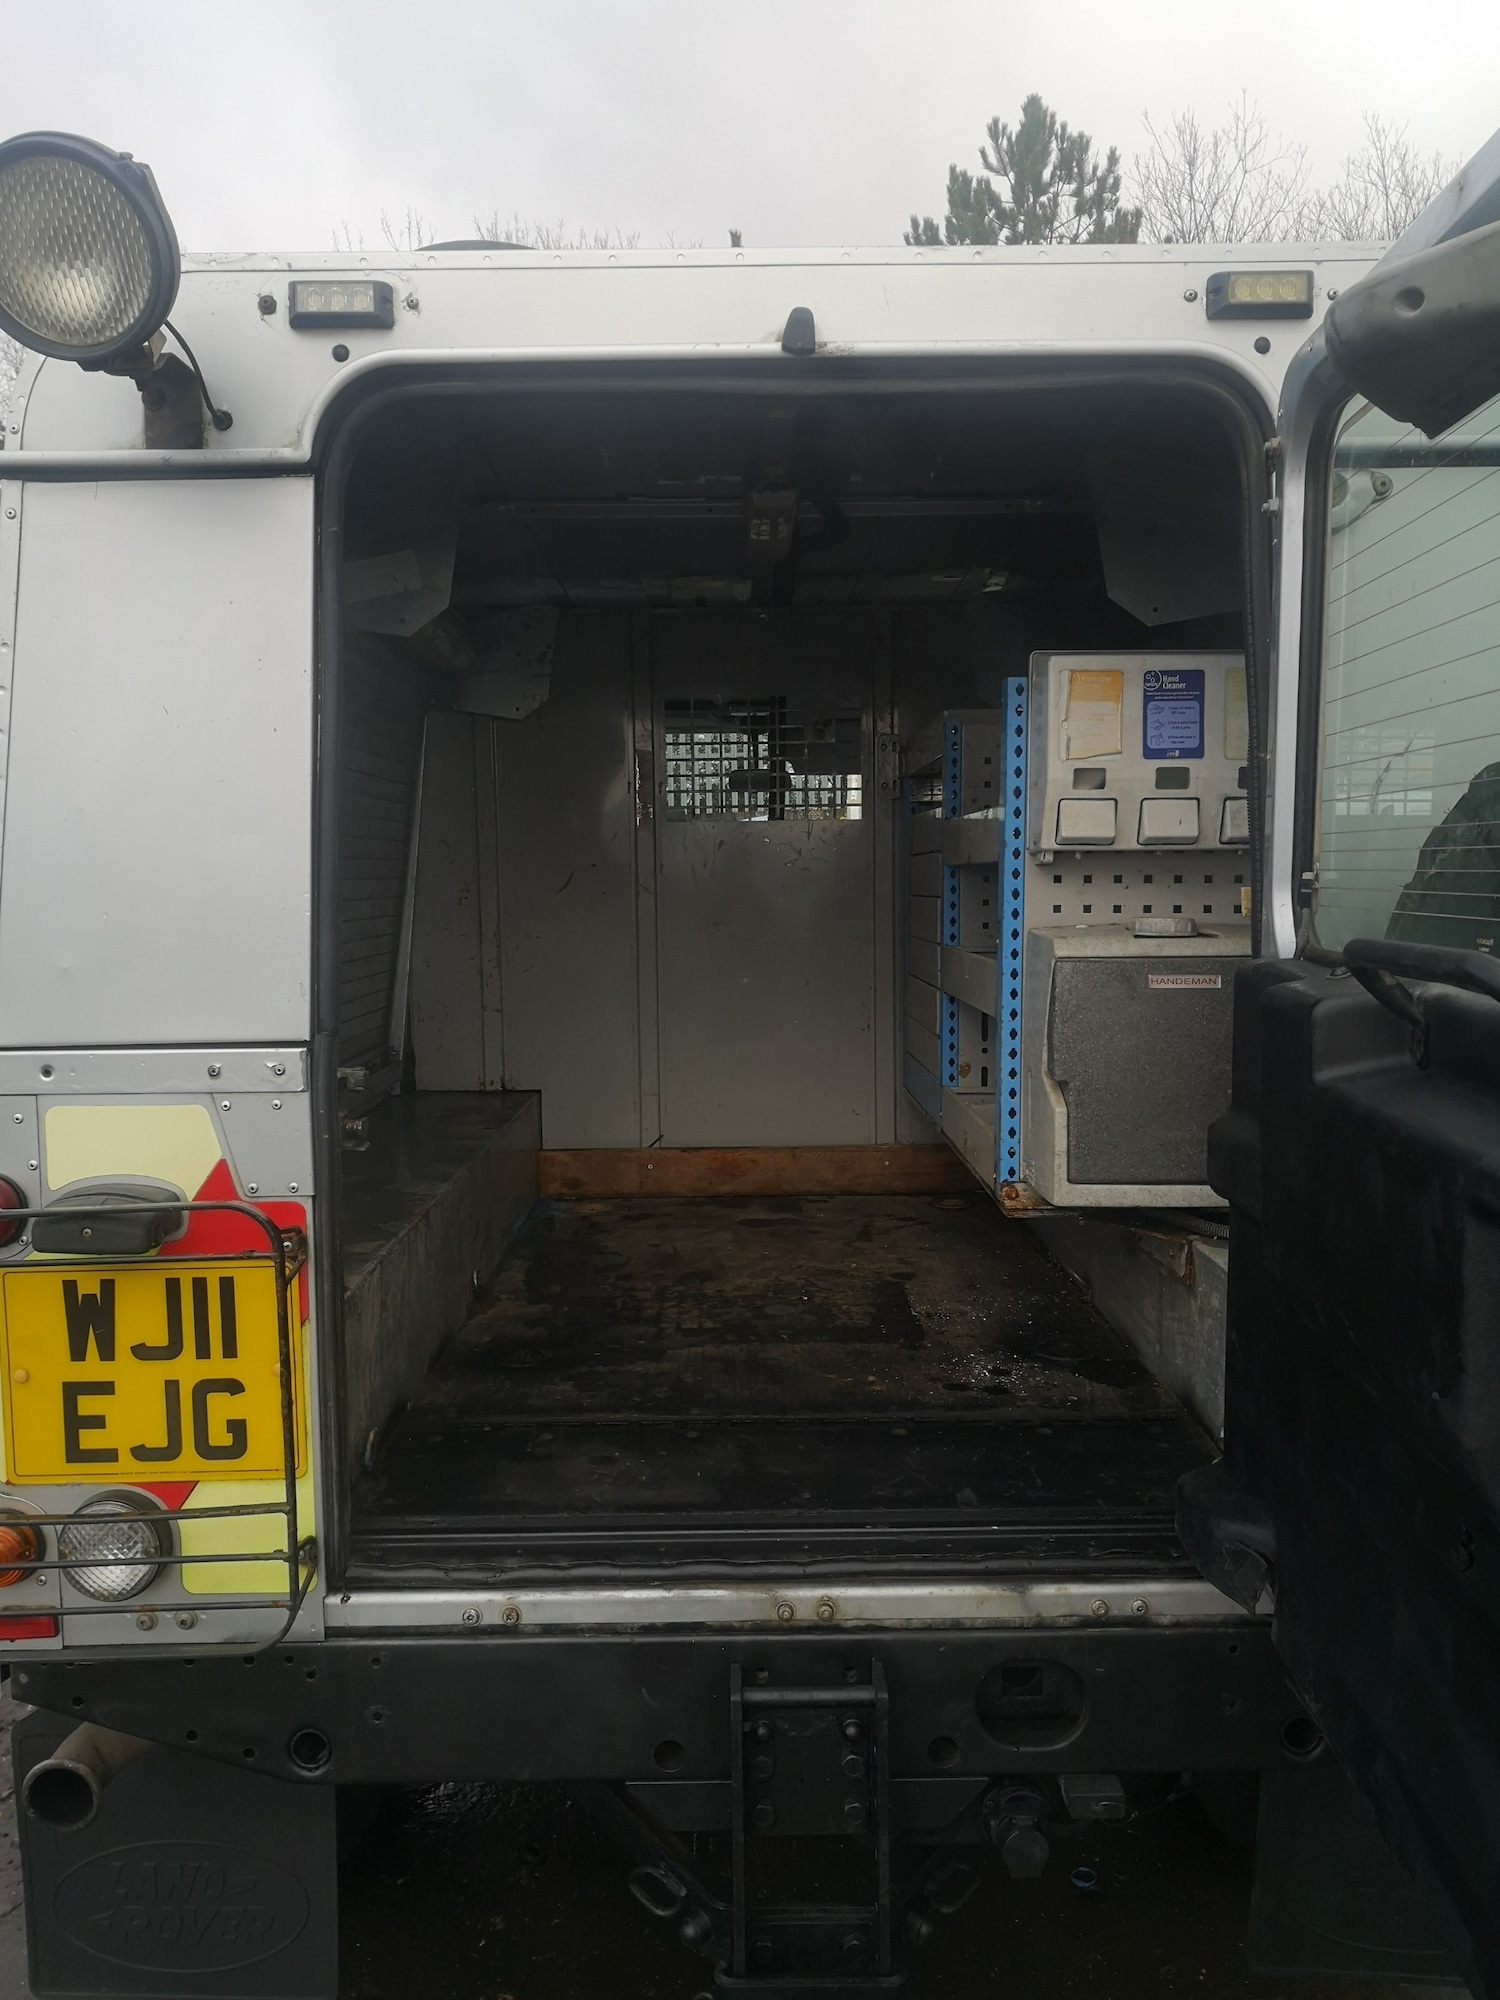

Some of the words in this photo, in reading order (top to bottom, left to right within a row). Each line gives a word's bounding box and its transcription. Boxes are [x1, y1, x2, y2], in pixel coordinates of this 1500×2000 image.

[1162, 682, 1187, 690] Cleaner
[1150, 977, 1217, 985] HANDEMAN
[62, 1276, 238, 1363] WJ11
[62, 1378, 248, 1464] EJG
[104, 1861, 228, 1902] LAND
[119, 1903, 276, 1946] ROVER
